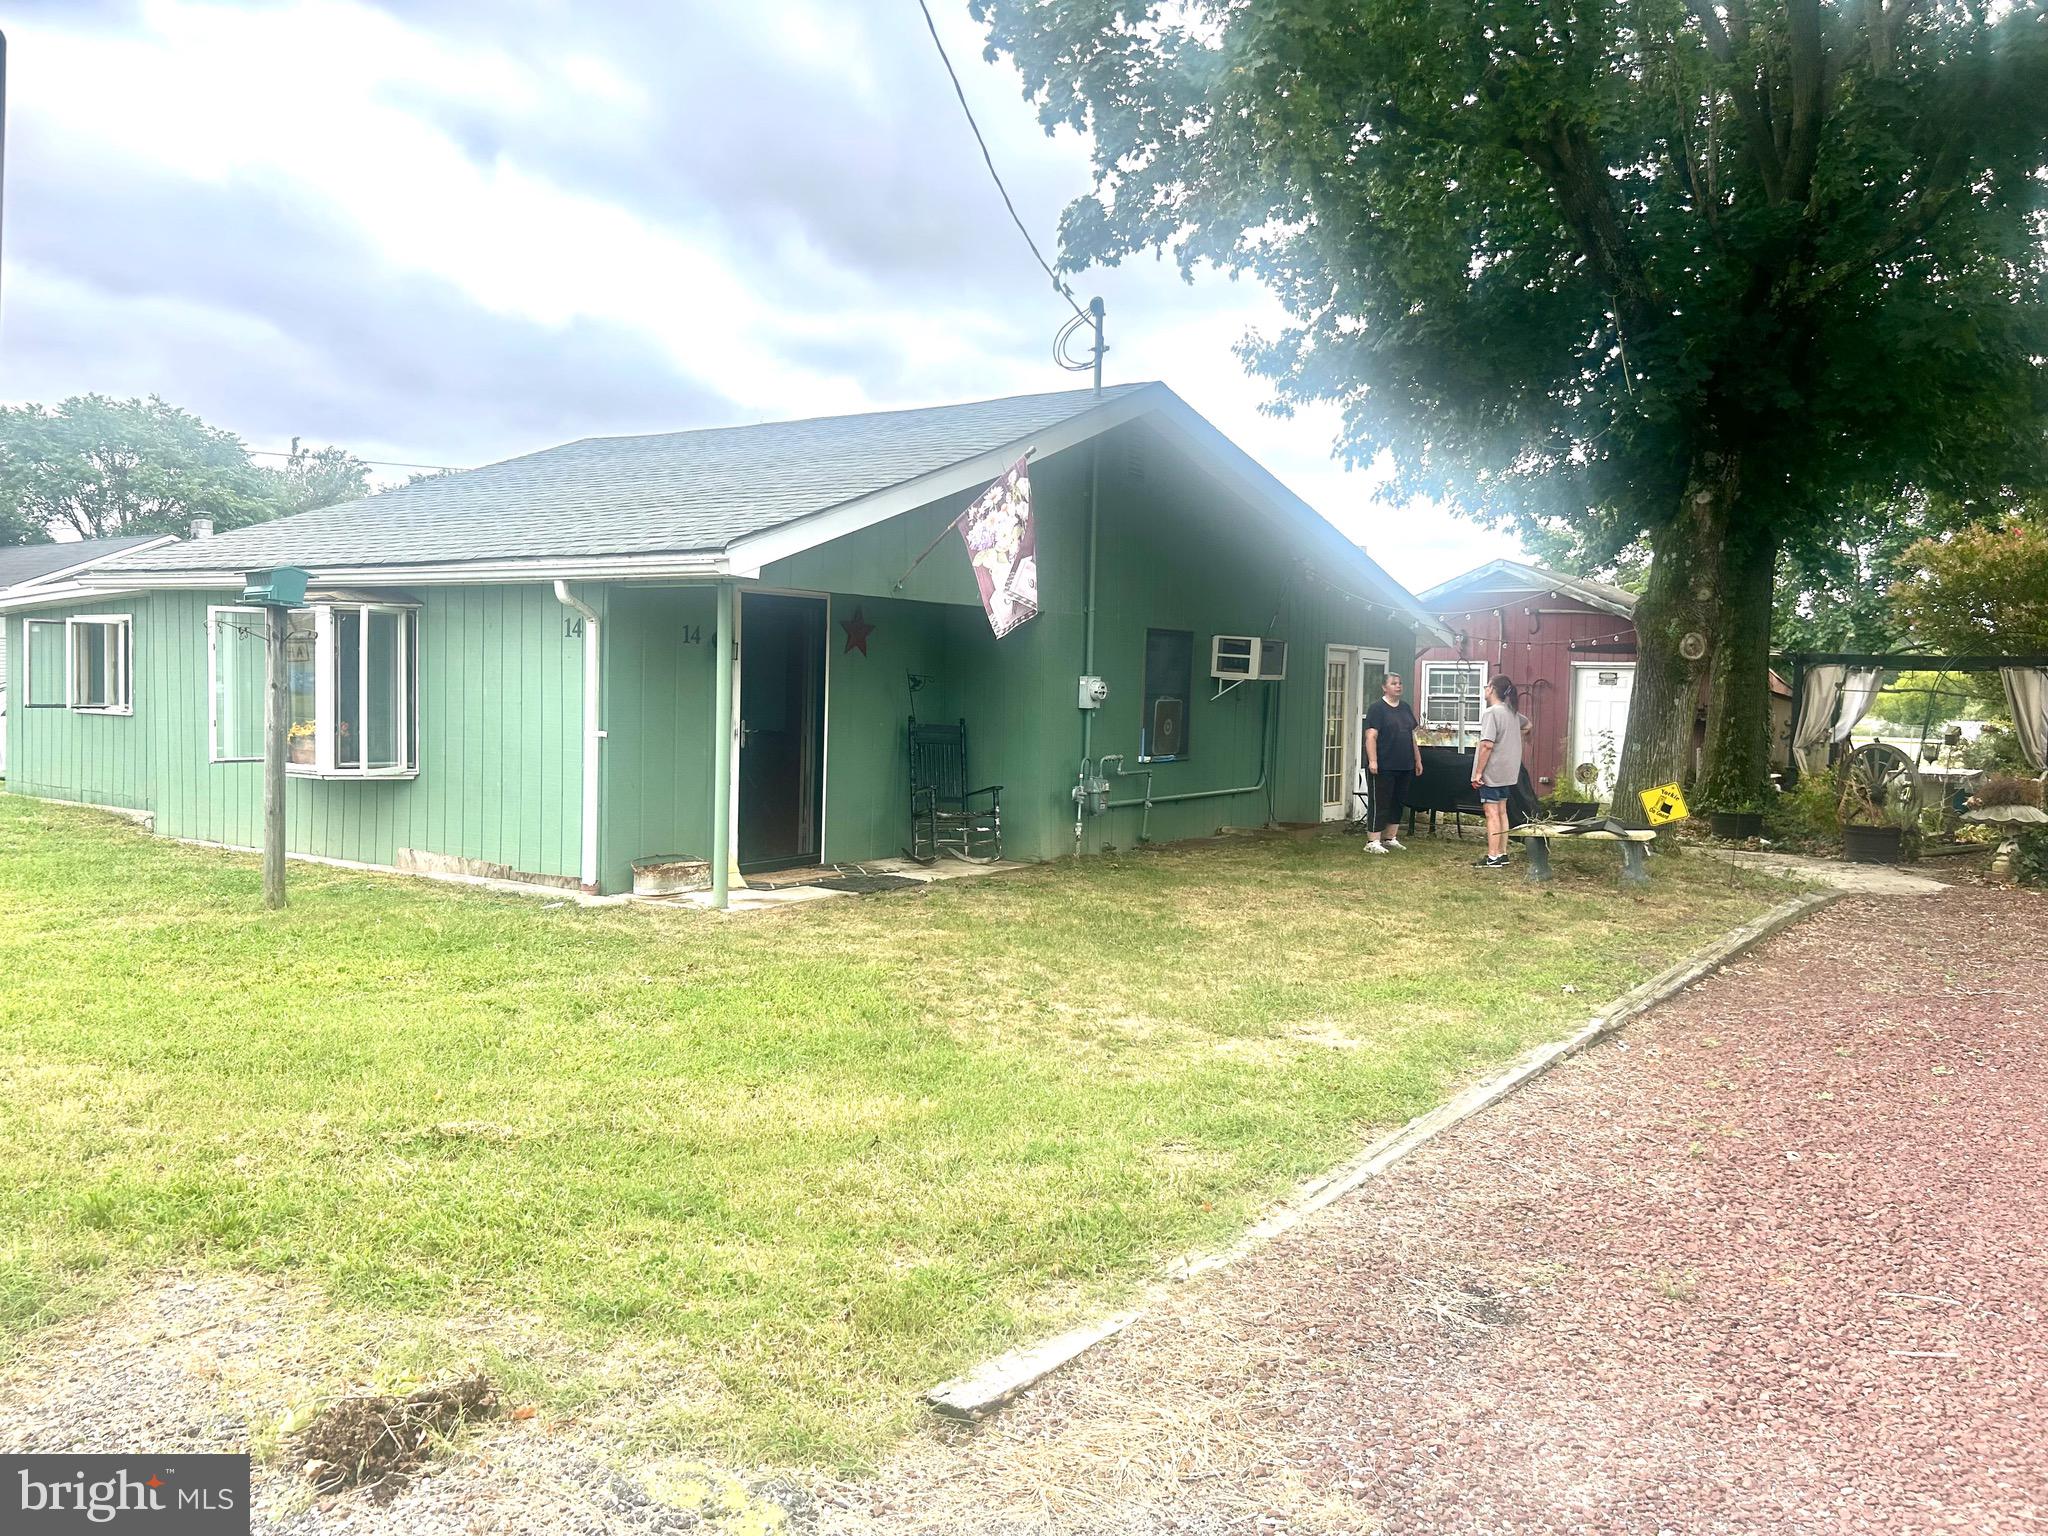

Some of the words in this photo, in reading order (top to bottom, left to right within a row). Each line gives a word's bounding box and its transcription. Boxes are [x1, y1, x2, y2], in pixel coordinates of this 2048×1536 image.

[564, 617, 582, 638] 14
[682, 624, 701, 644] 14
[1661, 789, 1679, 801] Yorkie
